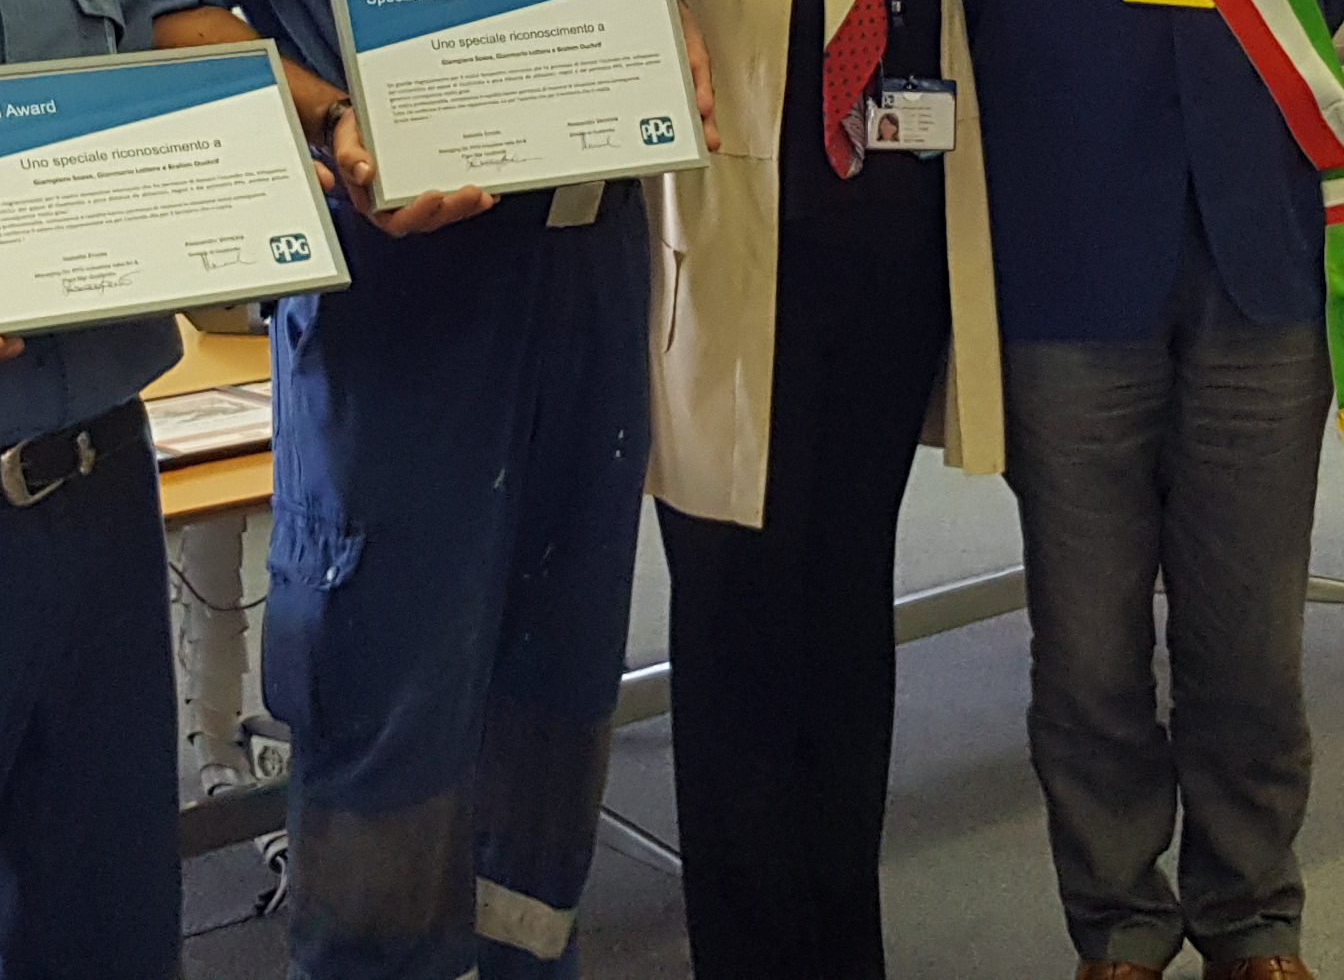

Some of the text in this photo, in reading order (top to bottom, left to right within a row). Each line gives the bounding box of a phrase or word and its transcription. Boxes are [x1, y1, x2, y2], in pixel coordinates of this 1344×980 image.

[431, 22, 605, 50] Uno speciale riconoscimento a
[6, 99, 57, 117] Award
[641, 119, 674, 143] PPG
[20, 139, 222, 171] Uno speciale riconoscimento a
[272, 235, 310, 263] PPG
